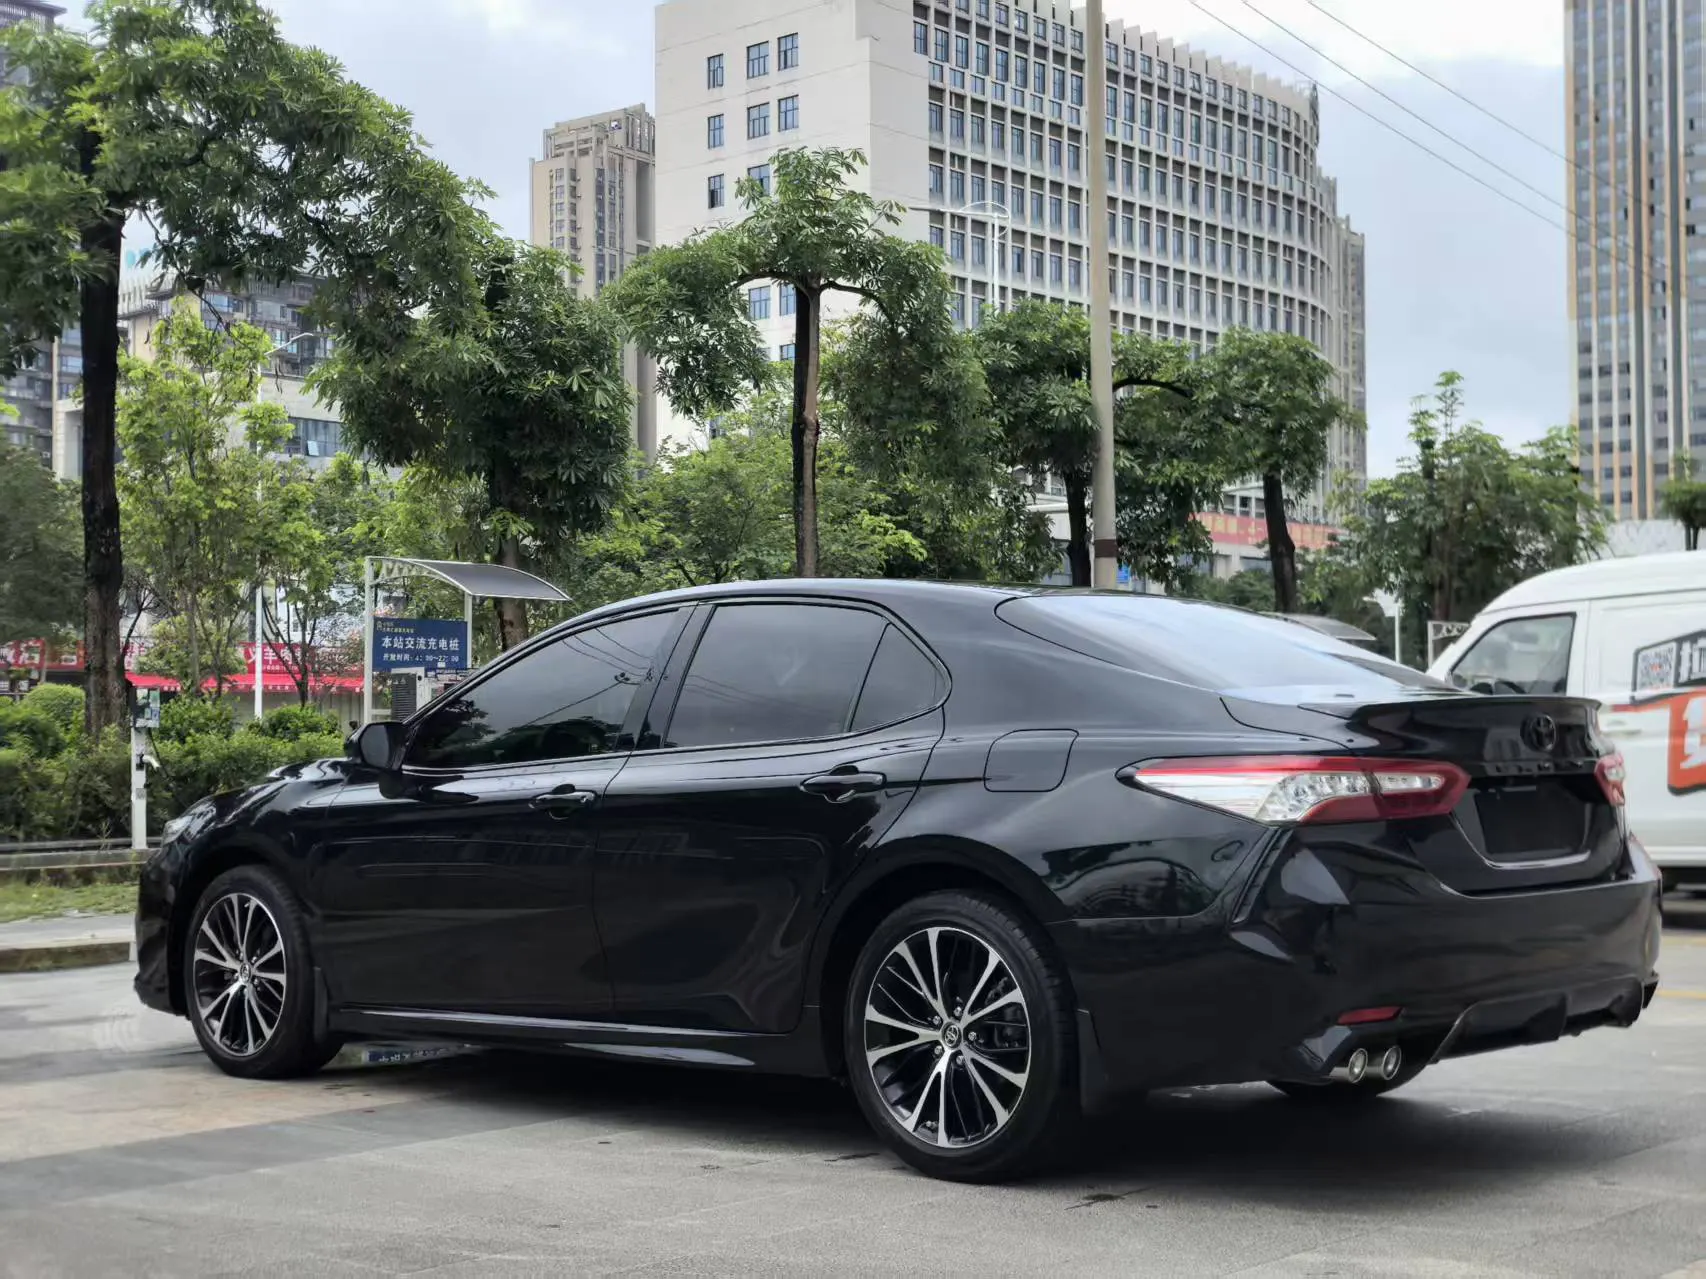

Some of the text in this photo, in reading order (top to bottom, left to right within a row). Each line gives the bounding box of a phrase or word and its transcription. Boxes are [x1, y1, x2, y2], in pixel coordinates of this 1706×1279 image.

[381, 635, 460, 651] 本站交流充电桩
